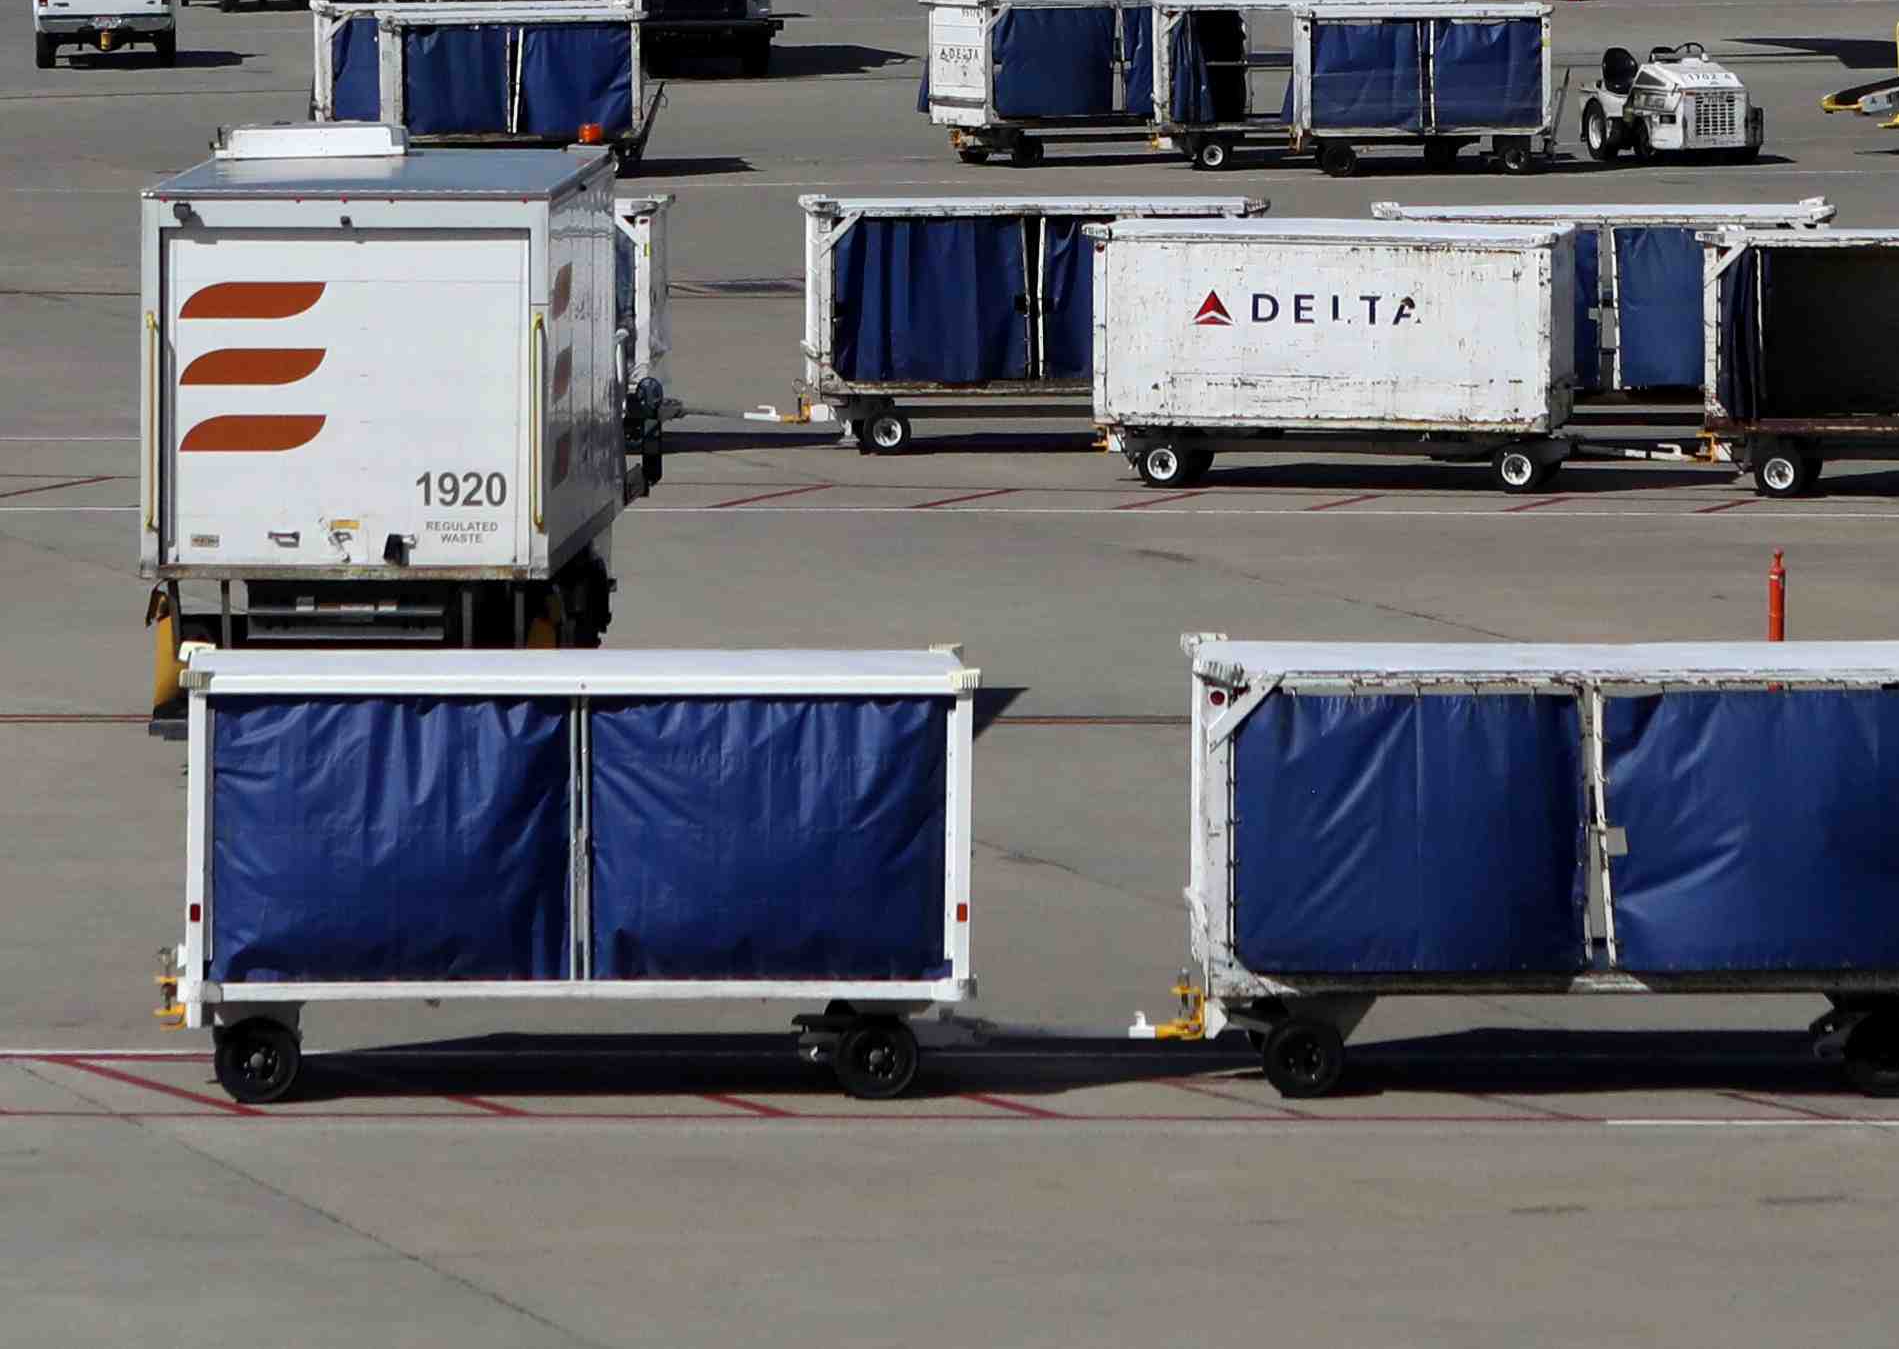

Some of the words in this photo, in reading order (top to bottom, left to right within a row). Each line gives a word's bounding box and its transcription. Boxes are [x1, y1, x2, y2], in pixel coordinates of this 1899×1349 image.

[1252, 293, 1421, 325] DELTA
[416, 471, 507, 507] 1920
[425, 521, 498, 532] REGULATED
[441, 533, 483, 544] WASTE
